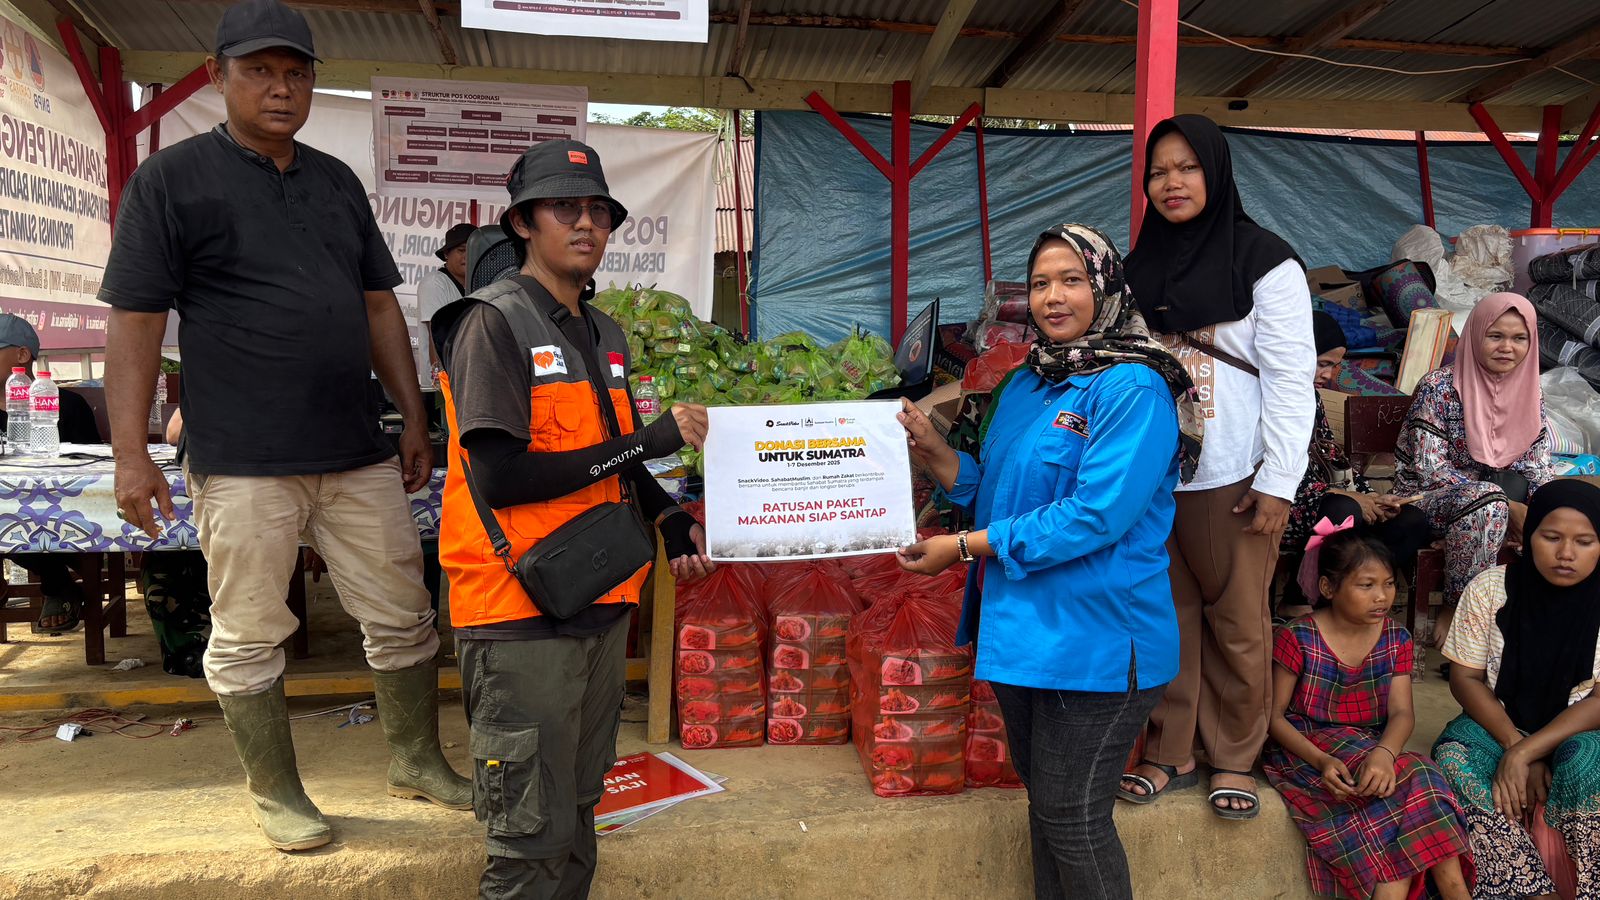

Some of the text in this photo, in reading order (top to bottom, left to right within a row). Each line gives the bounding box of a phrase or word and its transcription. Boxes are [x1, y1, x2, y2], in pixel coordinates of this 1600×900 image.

[754, 437, 867, 451] DONASI BERSAMA
[602, 444, 644, 471] MOUTAN
[758, 447, 866, 462] UNTUK SUMATRA
[763, 497, 865, 512] RATUSAN PAKET
[738, 507, 887, 525] MAKANAN SIAP SANTAP
[603, 772, 641, 786] NAN
[606, 780, 648, 794] SAJI
